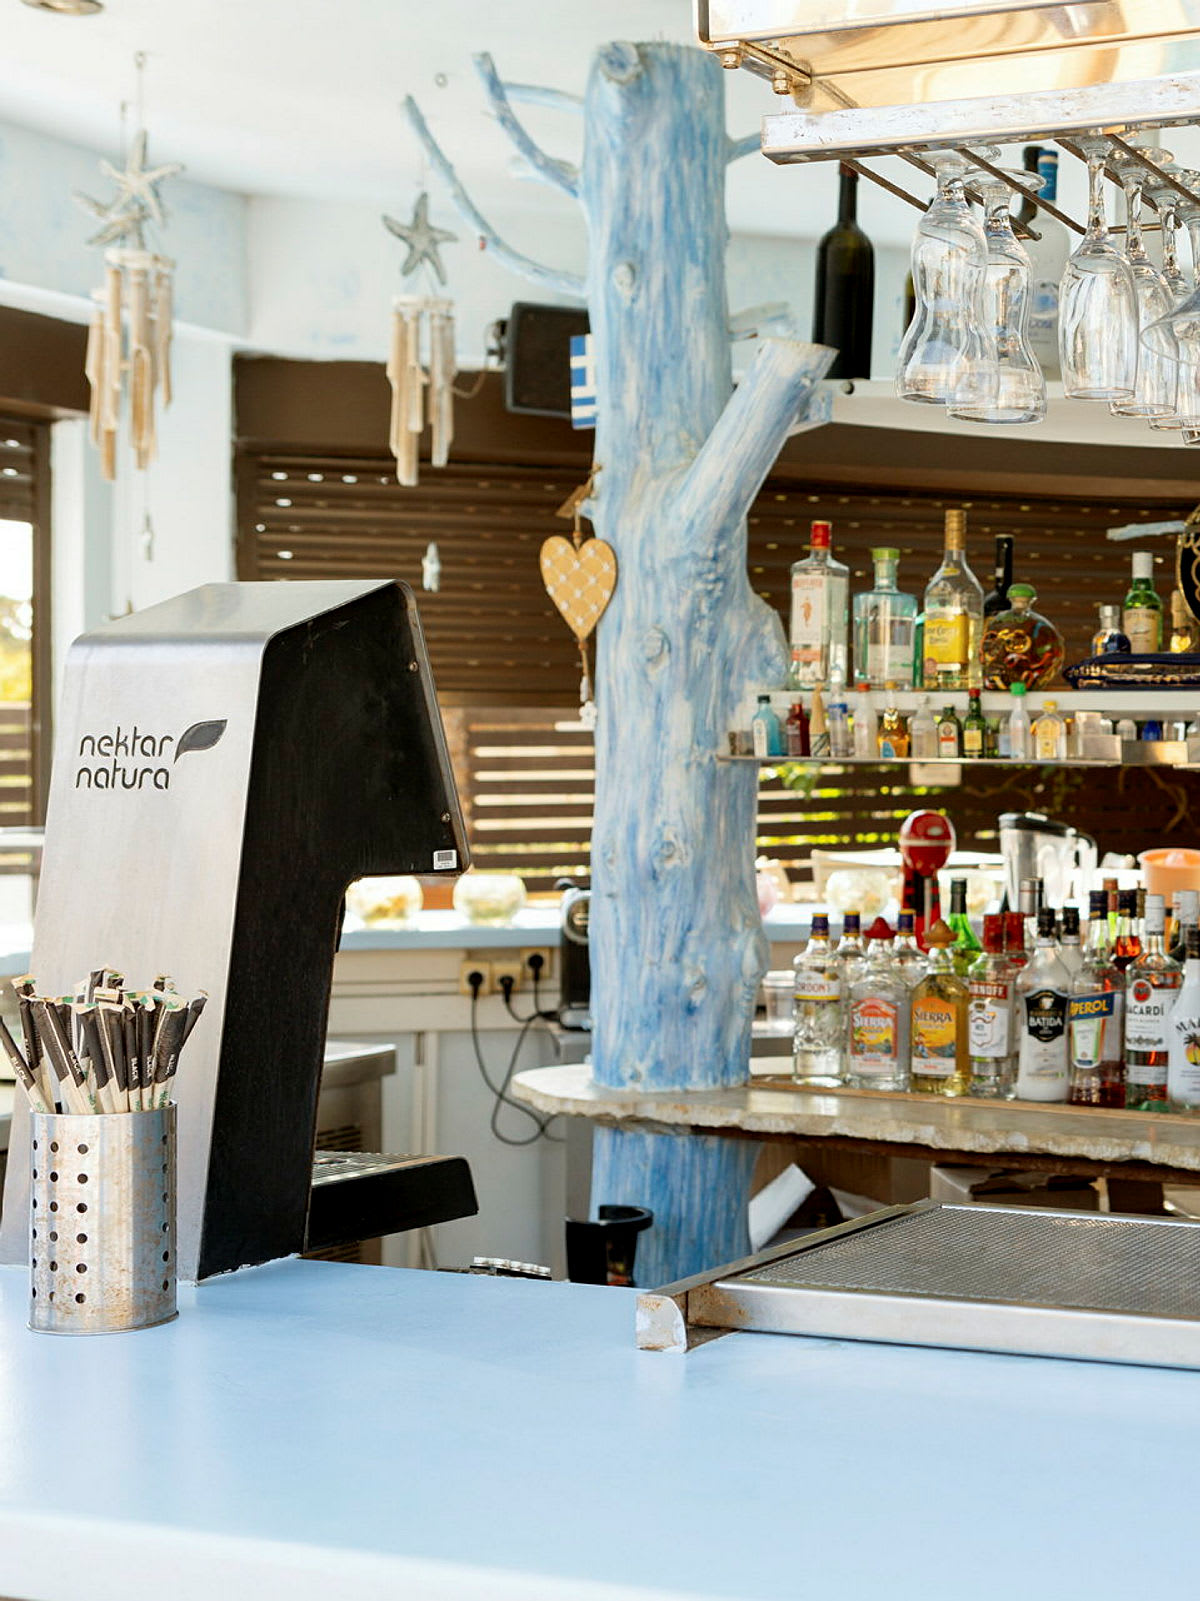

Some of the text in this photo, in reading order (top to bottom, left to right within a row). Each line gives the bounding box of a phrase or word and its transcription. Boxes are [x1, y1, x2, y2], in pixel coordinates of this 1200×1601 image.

[79, 725, 174, 757] nektar
[75, 758, 170, 790] natura
[913, 1006, 953, 1023] SIERRA
[1029, 1016, 1063, 1027] BATIDA
[1126, 1003, 1164, 1016] ACARDÍ
[10, 1056, 28, 1081] BLACK
[130, 1056, 139, 1081] BLACK
